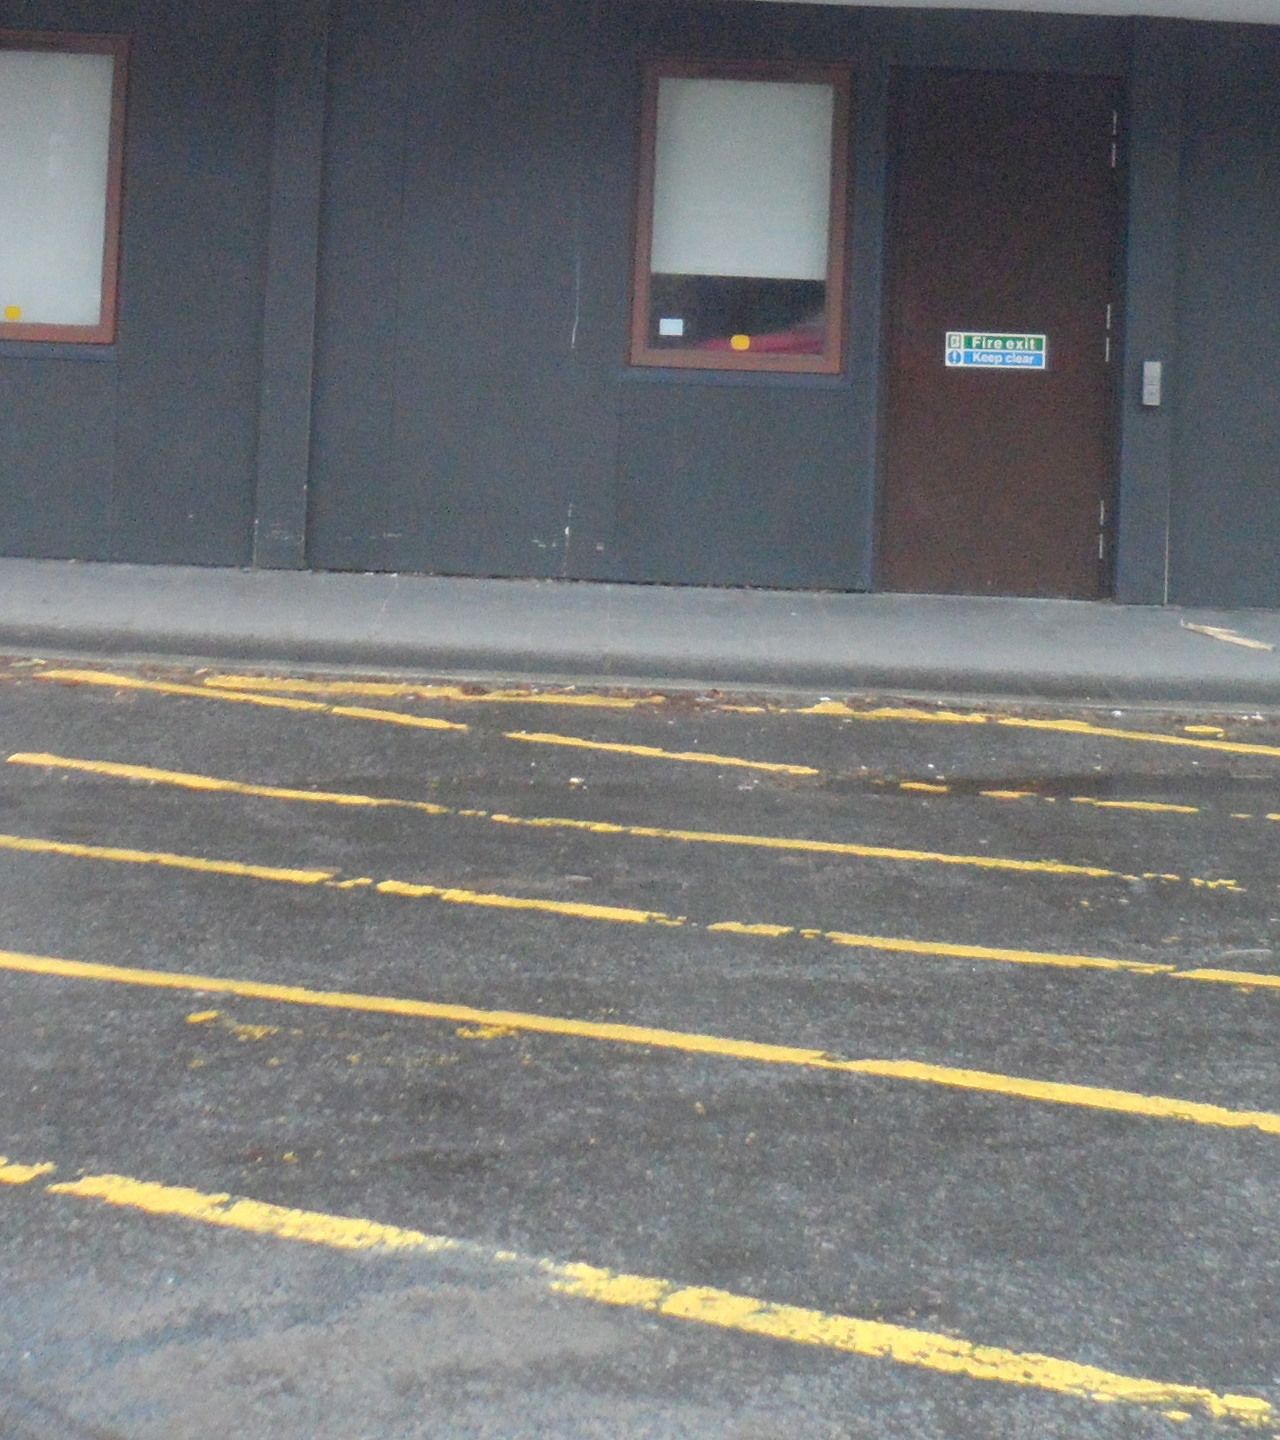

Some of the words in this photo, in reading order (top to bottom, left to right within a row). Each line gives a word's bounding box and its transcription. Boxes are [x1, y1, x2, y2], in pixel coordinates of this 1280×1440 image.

[972, 336, 1002, 349] Fire
[1006, 336, 1036, 350] exit
[972, 351, 1003, 365] Keep
[1005, 353, 1035, 364] clear
